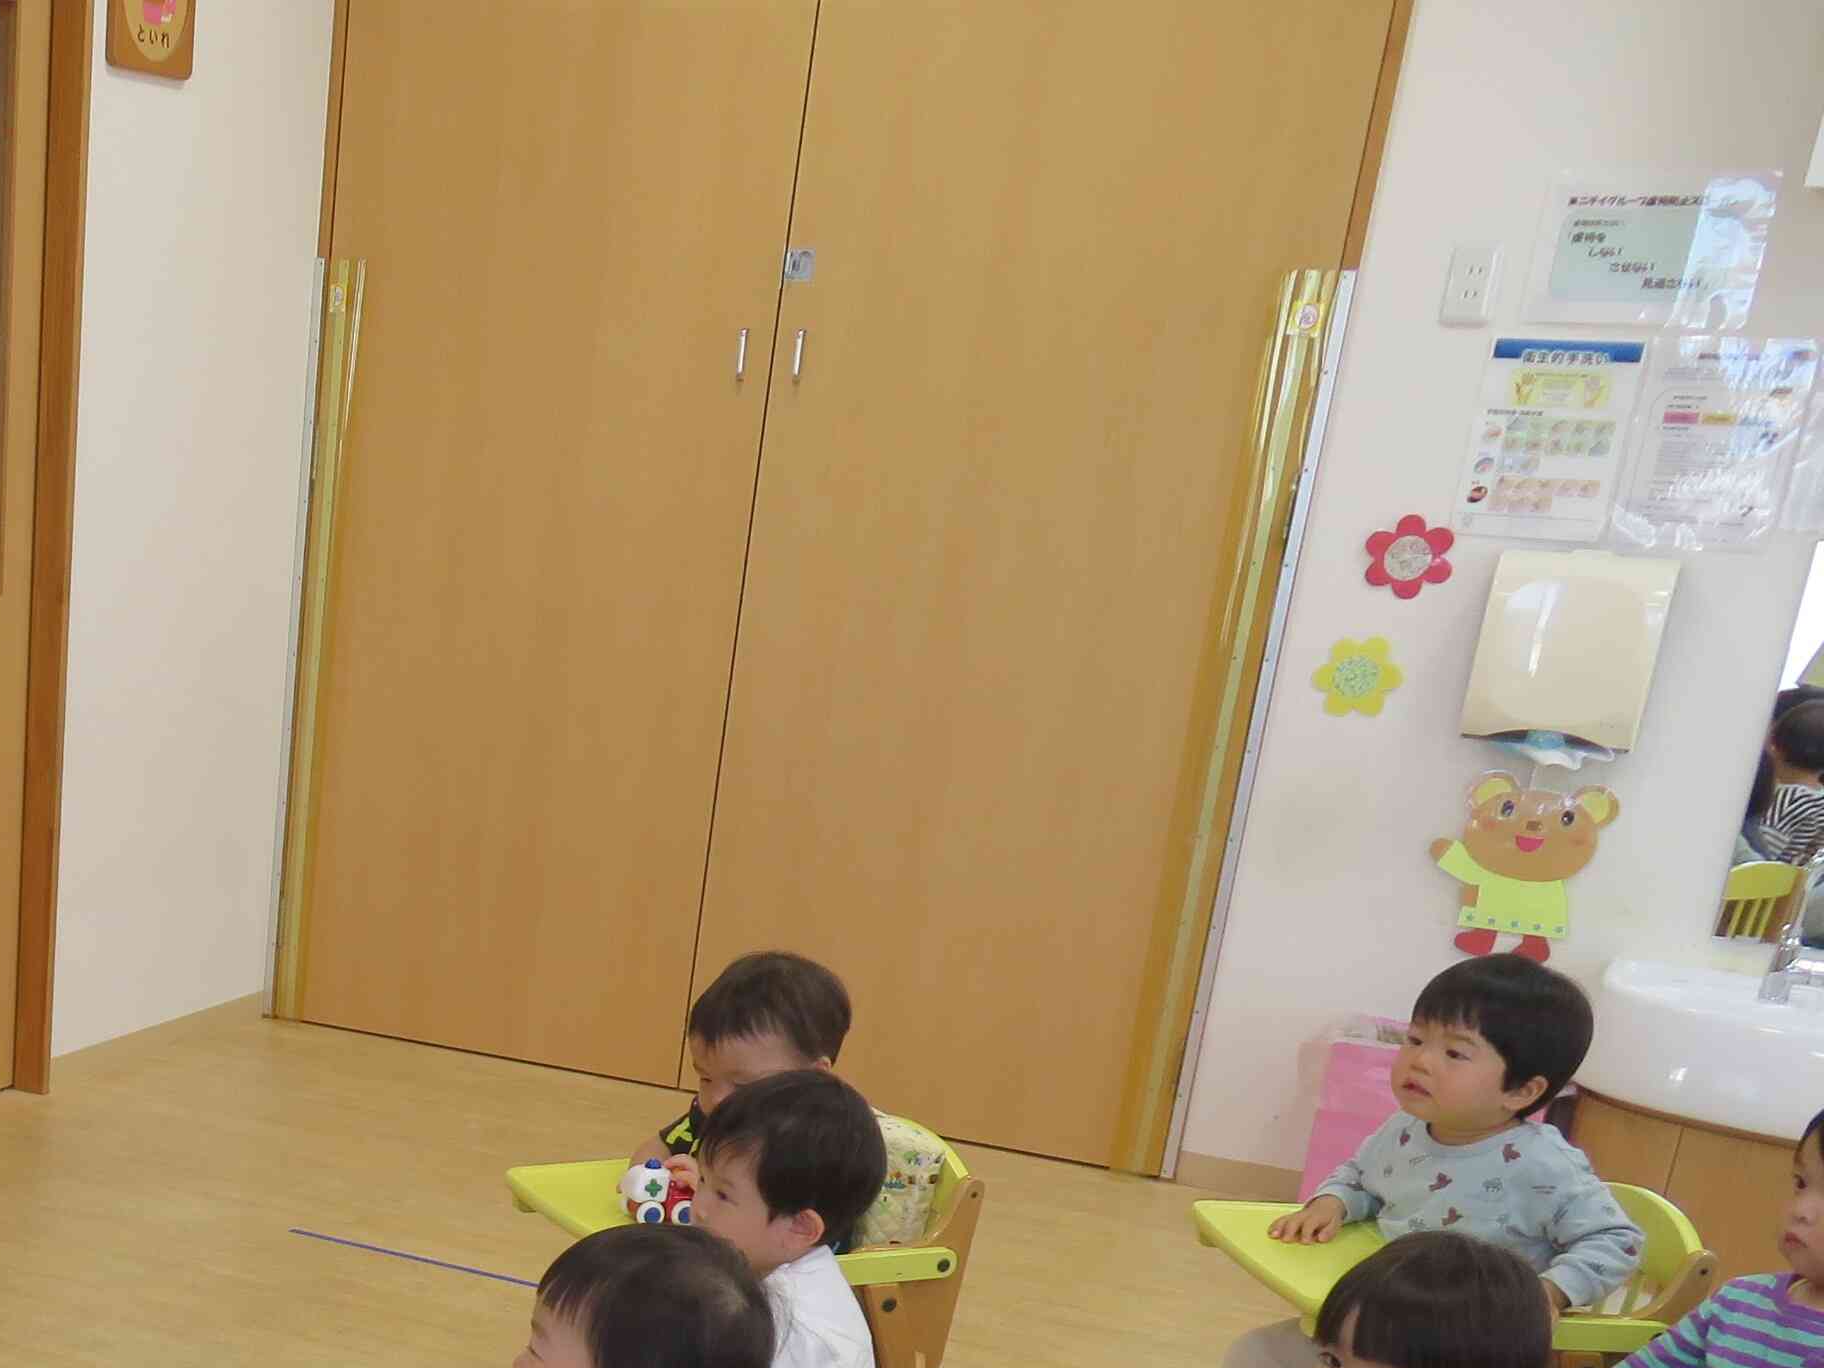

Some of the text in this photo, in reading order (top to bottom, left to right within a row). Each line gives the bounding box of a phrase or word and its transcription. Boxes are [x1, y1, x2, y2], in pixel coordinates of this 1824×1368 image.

[137, 24, 169, 48] といれ
[1523, 350, 1610, 366] 衛生的手洗い
